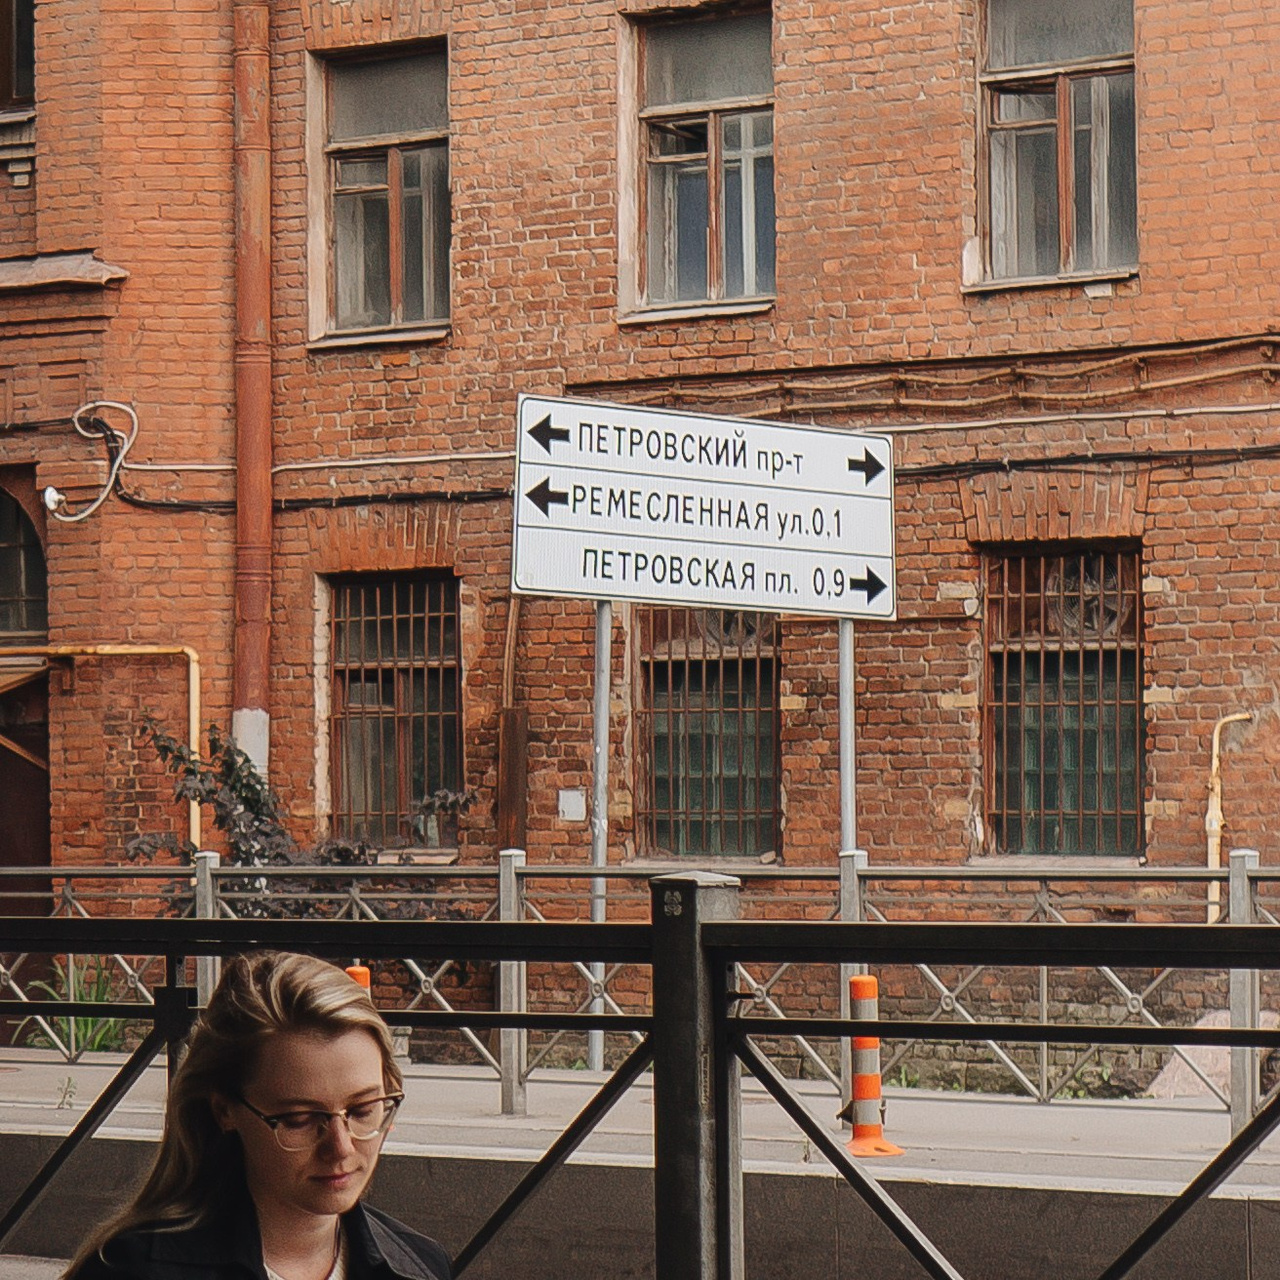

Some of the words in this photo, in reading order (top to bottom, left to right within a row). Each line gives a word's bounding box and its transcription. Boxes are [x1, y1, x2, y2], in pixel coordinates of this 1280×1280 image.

[578, 422, 748, 468] ПЕТРОВСКИЙ
[757, 449, 804, 479] пр-т
[572, 484, 769, 531] РЕМЕСЛЕННАЯ
[582, 548, 756, 591] ПЕТРОВСКАЯ
[765, 572, 799, 595] пл.
[813, 567, 845, 600] 0,9
